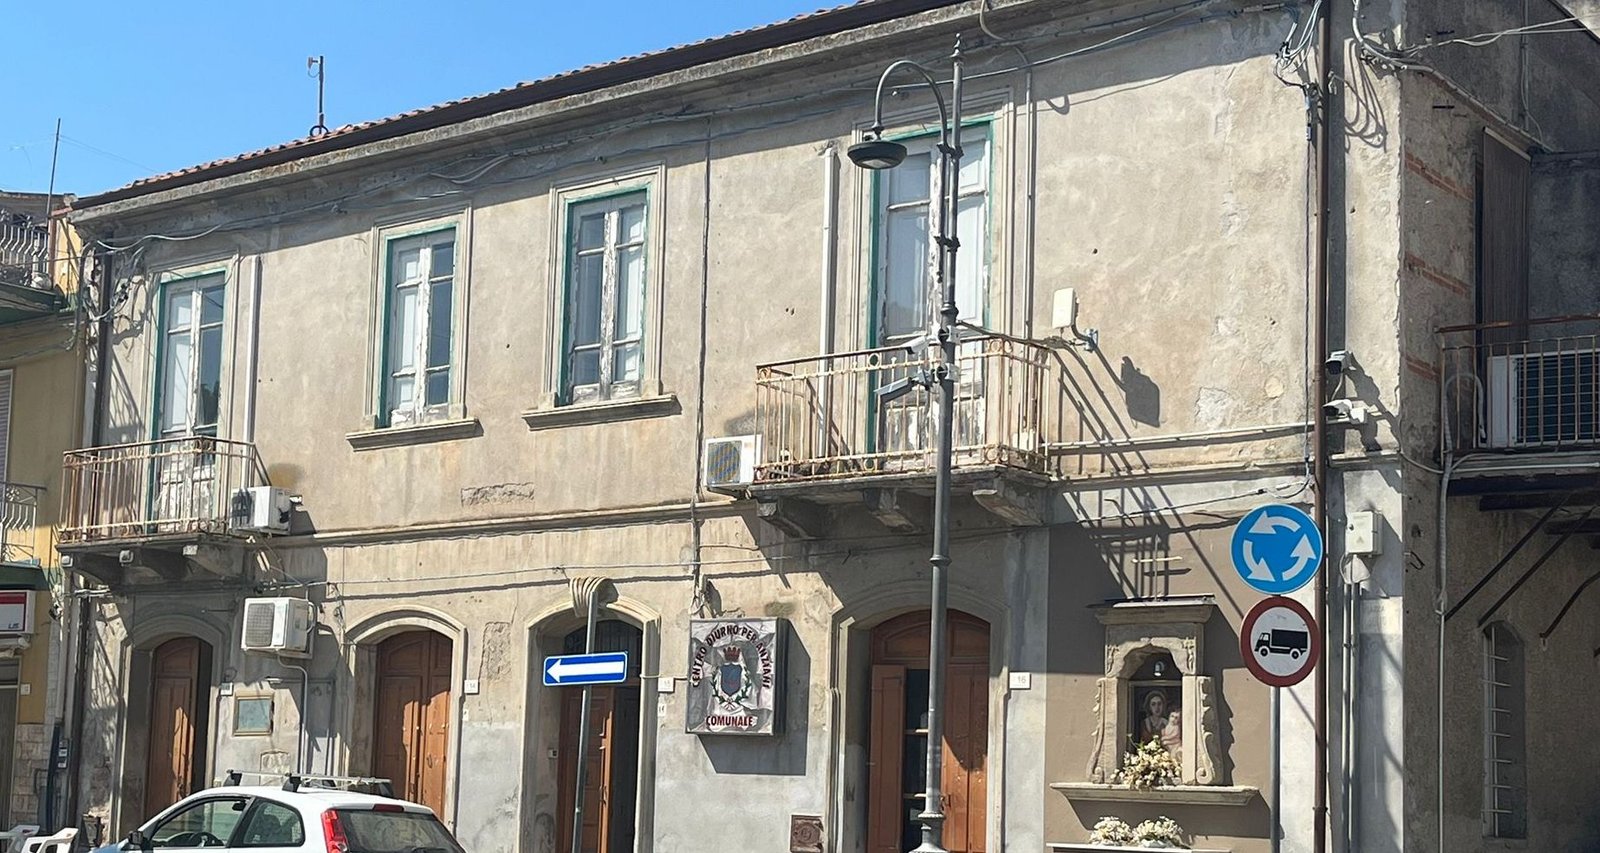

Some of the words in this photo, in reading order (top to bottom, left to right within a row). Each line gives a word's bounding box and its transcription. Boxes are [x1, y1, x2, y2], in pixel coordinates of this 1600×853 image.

[692, 646, 707, 688] CENTRO
[705, 625, 740, 647] DIURNO
[741, 626, 757, 644] PER
[756, 643, 773, 688] ANZIANI
[706, 715, 753, 727] COMUNALE
